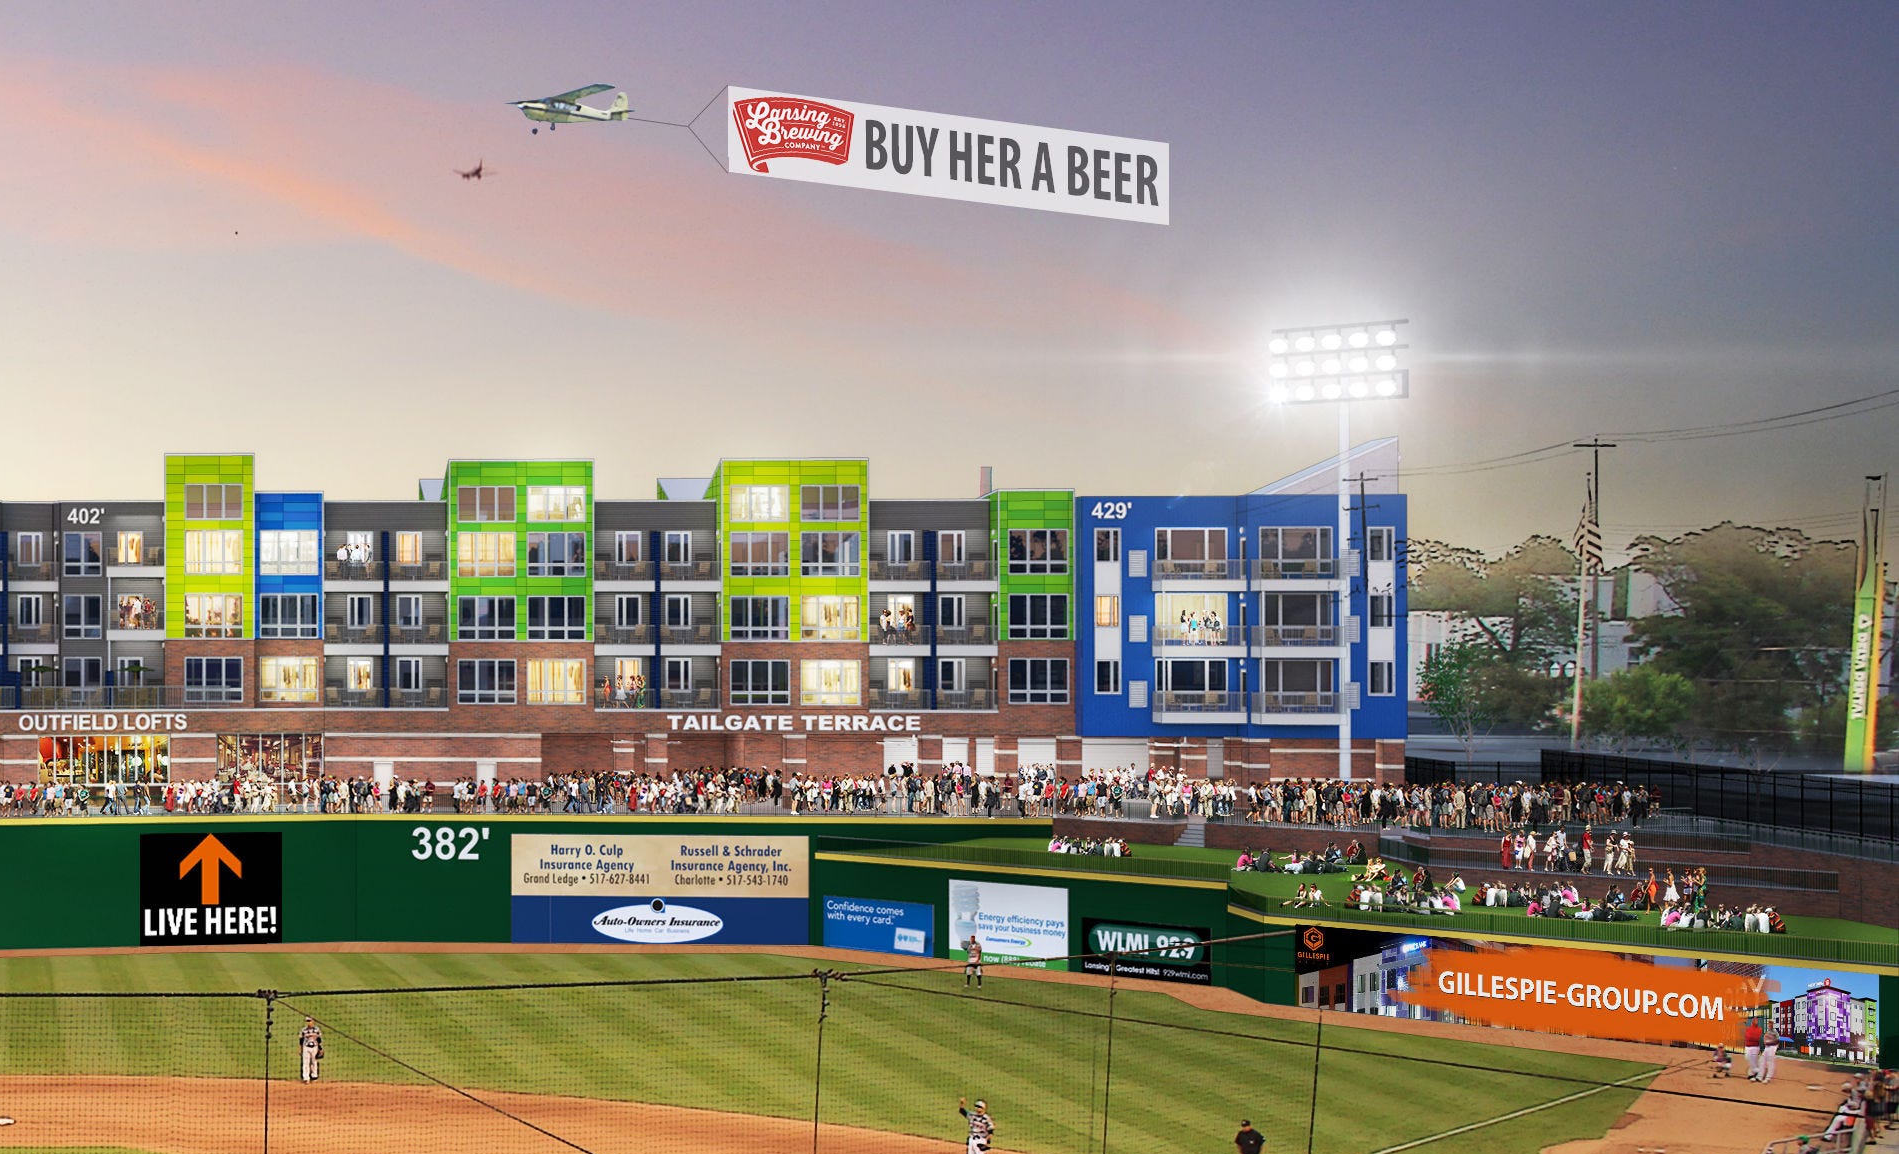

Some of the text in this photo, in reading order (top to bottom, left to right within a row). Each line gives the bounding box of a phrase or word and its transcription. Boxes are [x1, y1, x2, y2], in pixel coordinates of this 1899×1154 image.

[745, 101, 831, 129] Lansing
[758, 118, 844, 151] Brewing
[784, 142, 820, 151] COMPANY
[865, 118, 1160, 208] BUY HER A BEER
[67, 507, 105, 525] 402'
[1092, 501, 1133, 520] 429'
[18, 713, 187, 732] OUTFIELD LOFTS
[667, 713, 921, 732] TAILGATE TERRACE
[411, 827, 490, 861] 382'
[550, 844, 623, 858] Harry O. Culp
[680, 845, 782, 858] Russell & Schrader
[539, 859, 635, 873] Insurance Agency
[671, 860, 792, 874] Insurance Agency, Inc.
[523, 873, 650, 887] Grand Ledge 517-627-8441
[674, 874, 788, 886] Charlotte 517-543-1740
[827, 900, 904, 916] Confidence comes
[144, 906, 278, 937] LIVE HERE!
[593, 915, 721, 928] Auto-Owners Insurance
[827, 911, 894, 925] with every card.
[978, 911, 1065, 929] Energy efficiency pays
[995, 925, 1010, 933] your
[1011, 925, 1041, 935] business
[1042, 929, 1066, 939] money
[1096, 929, 1196, 959] WLMI 92.9
[983, 955, 999, 963] now
[1297, 951, 1330, 961] GILLESPIE
[1115, 964, 1144, 974] Greatest
[1162, 968, 1208, 980] 929wlmi.com
[1438, 970, 1724, 1022] GILLESPIE-GROUP.COM
